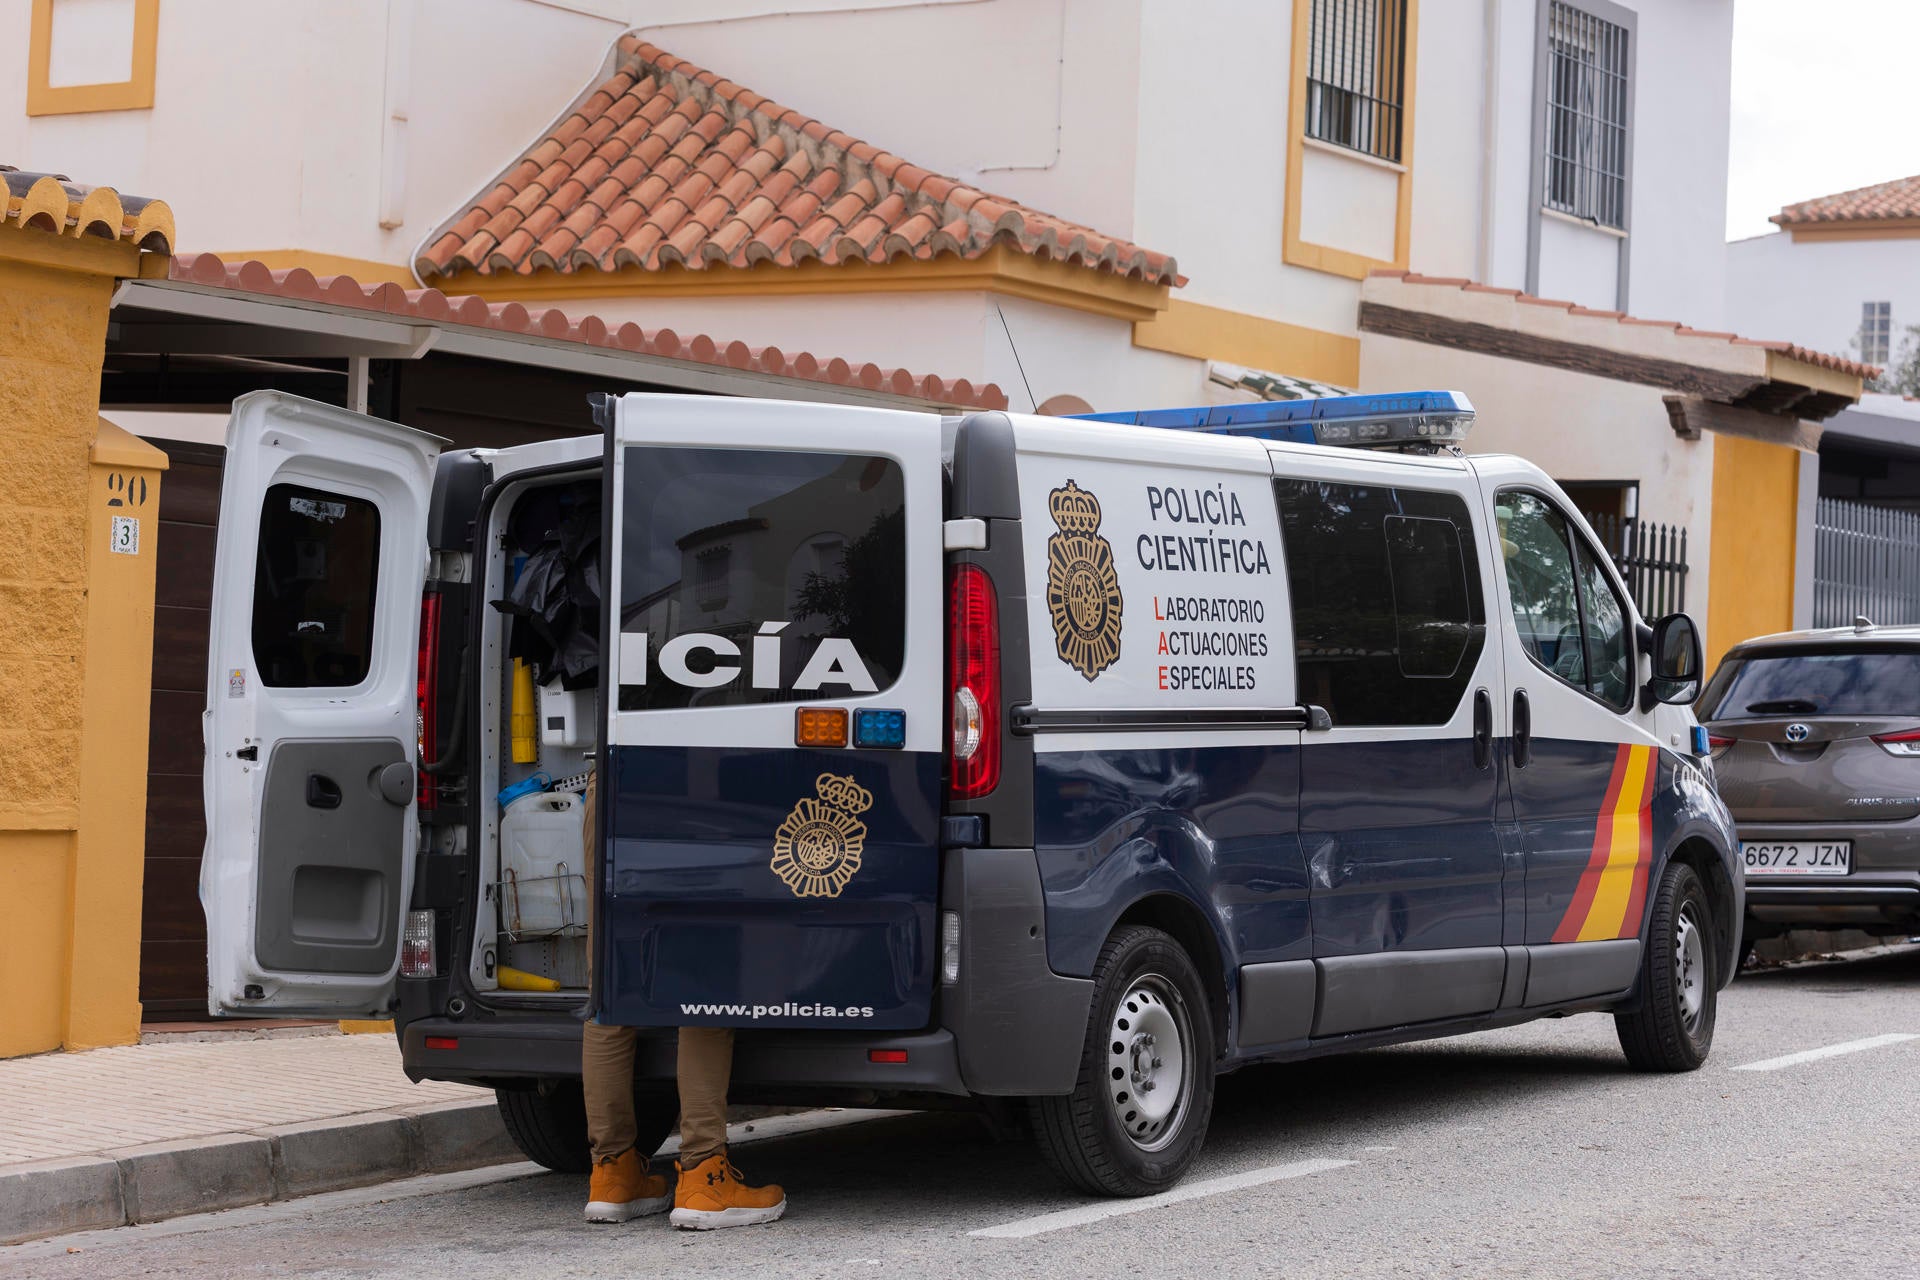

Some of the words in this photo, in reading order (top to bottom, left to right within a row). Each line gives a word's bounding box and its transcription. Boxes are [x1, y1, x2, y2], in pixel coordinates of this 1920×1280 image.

[107, 472, 147, 507] 20
[1147, 483, 1246, 526] POLICÍA
[120, 525, 130, 546] 3
[1136, 529, 1271, 575] CIENTÍFICA
[1154, 596, 1264, 623] LABORATORIO
[619, 621, 879, 692] ICÍA
[1158, 631, 1268, 657] ACTUACIONES
[1158, 666, 1256, 690] ESPECIALES
[1745, 846, 1798, 866] 6672
[1806, 846, 1848, 866] JZN
[680, 1002, 874, 1019] www.policia.es
